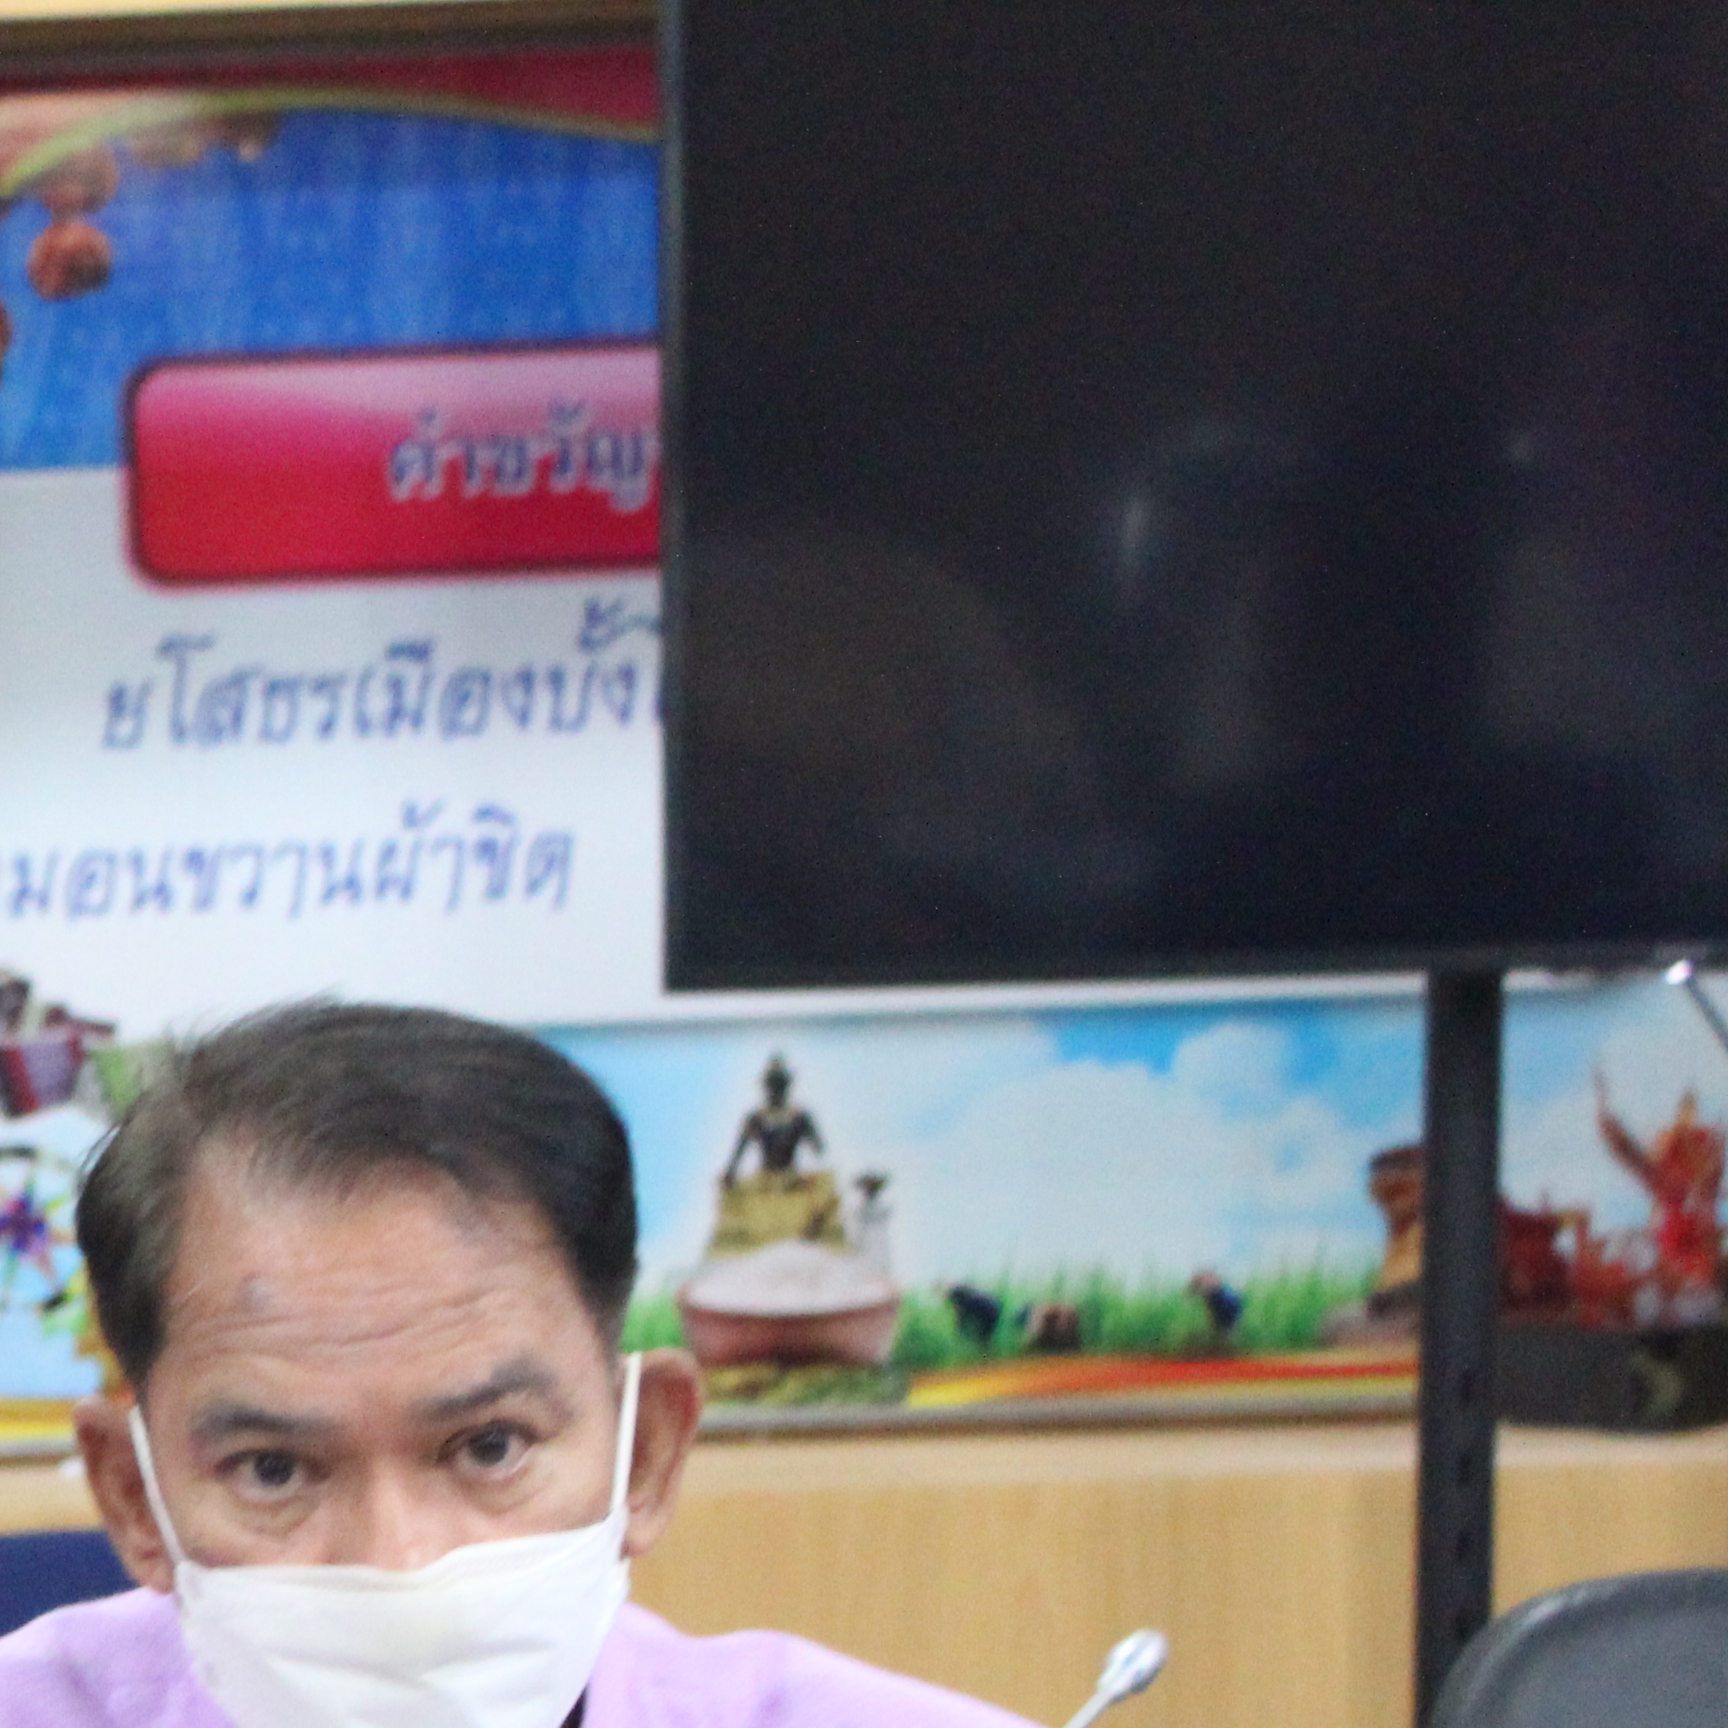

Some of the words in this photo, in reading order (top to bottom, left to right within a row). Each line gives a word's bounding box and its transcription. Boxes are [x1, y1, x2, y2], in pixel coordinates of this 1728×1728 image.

[102, 597, 663, 750] ยโสธรเมืองบั้ง
